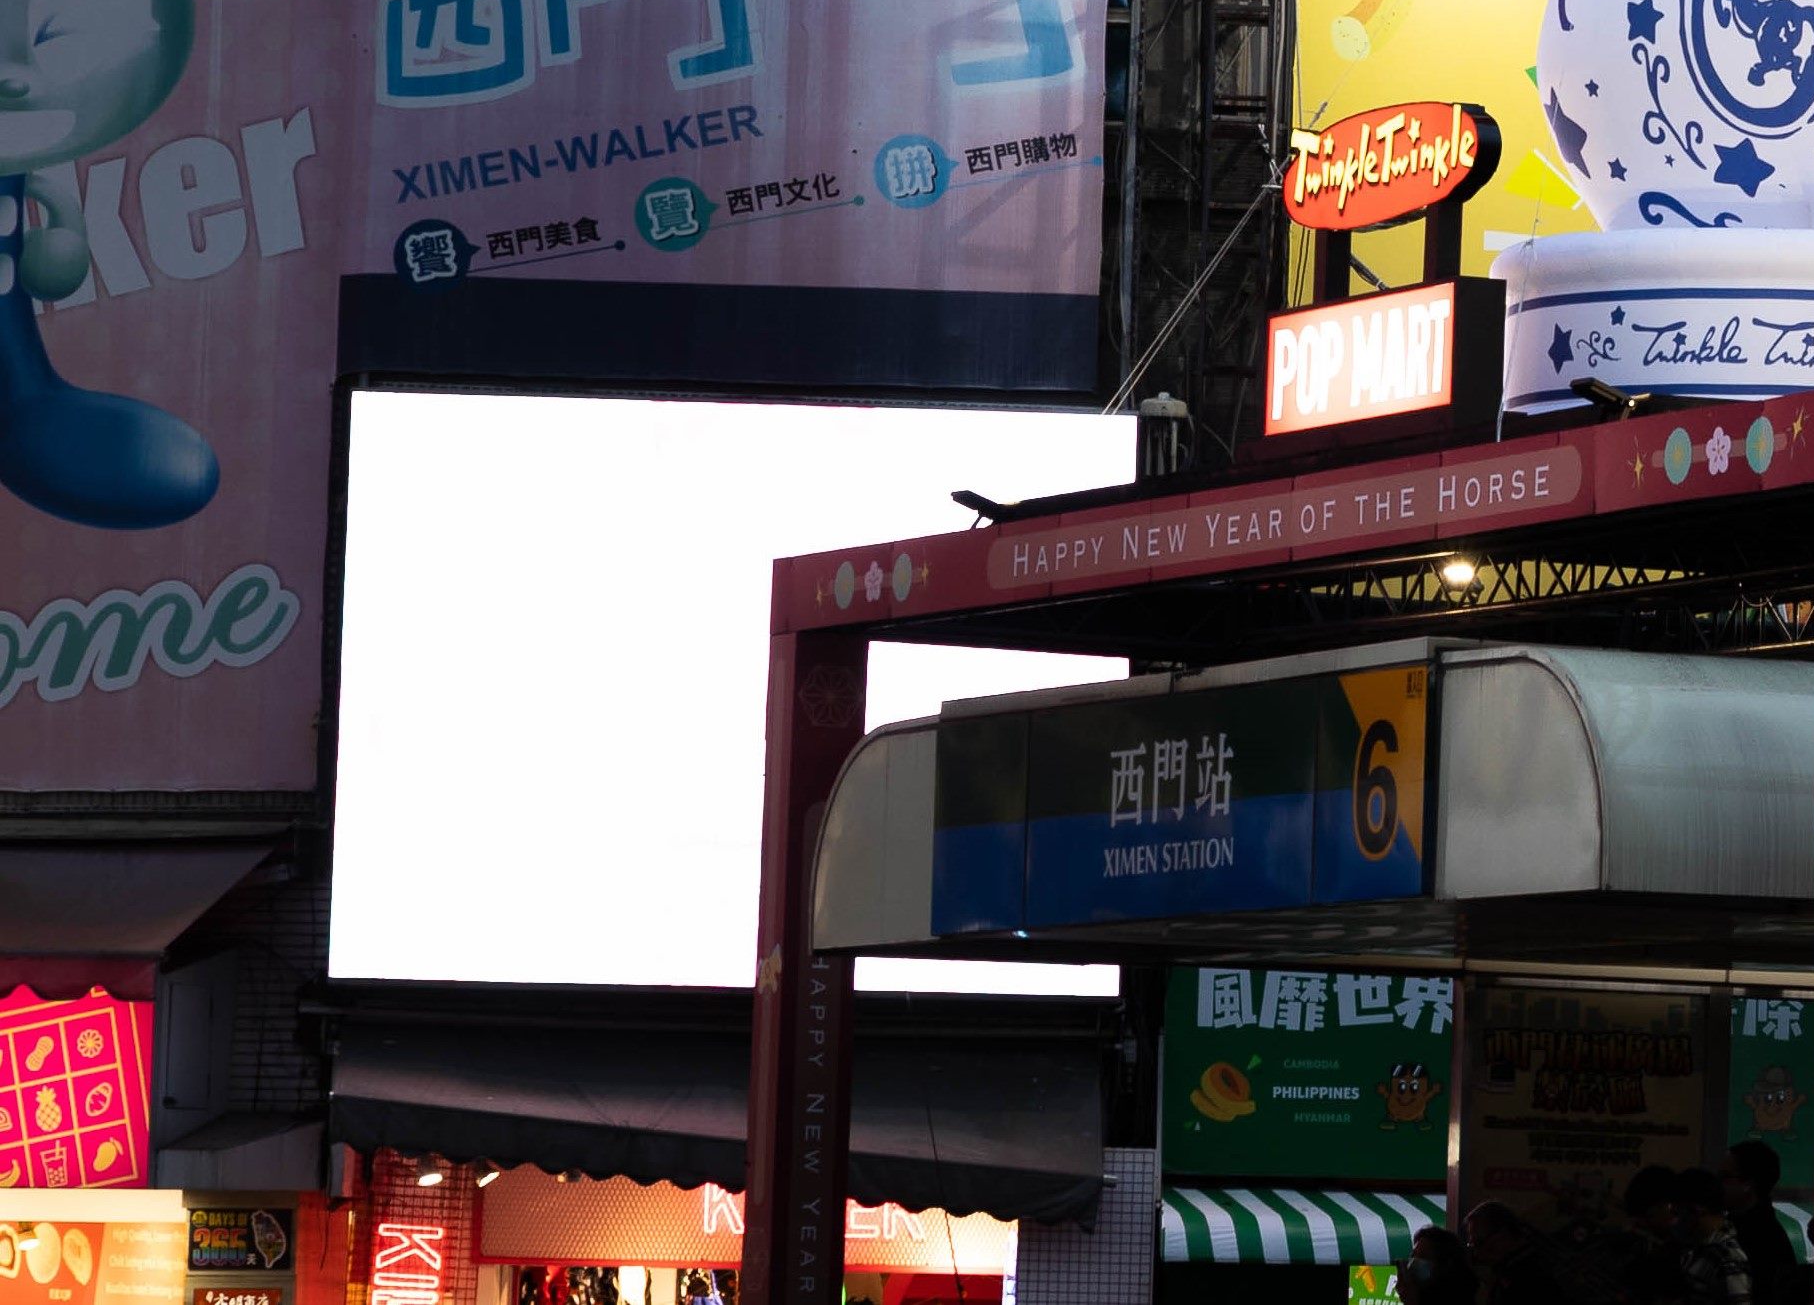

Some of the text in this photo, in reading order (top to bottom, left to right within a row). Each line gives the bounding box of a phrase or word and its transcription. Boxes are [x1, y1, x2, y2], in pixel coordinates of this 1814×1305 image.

[392, 104, 764, 204] XIMEN-WALKER
[965, 132, 1078, 175] 西門購物
[726, 172, 840, 217] 西門文化
[486, 215, 601, 260] 西門美食
[1272, 298, 1451, 424] POP MART
[1632, 315, 1748, 366] Twinkle
[1012, 463, 1553, 579] HAPPY NEW YEAR OF THE HORSE
[1109, 731, 1235, 829] 西門站
[1352, 718, 1400, 862] 6
[1103, 836, 1235, 879] XIMEN STATION
[803, 1093, 827, 1174] NEW
[1271, 1085, 1361, 1101] PHILIPPINES
[798, 1196, 823, 1292] YEAR
